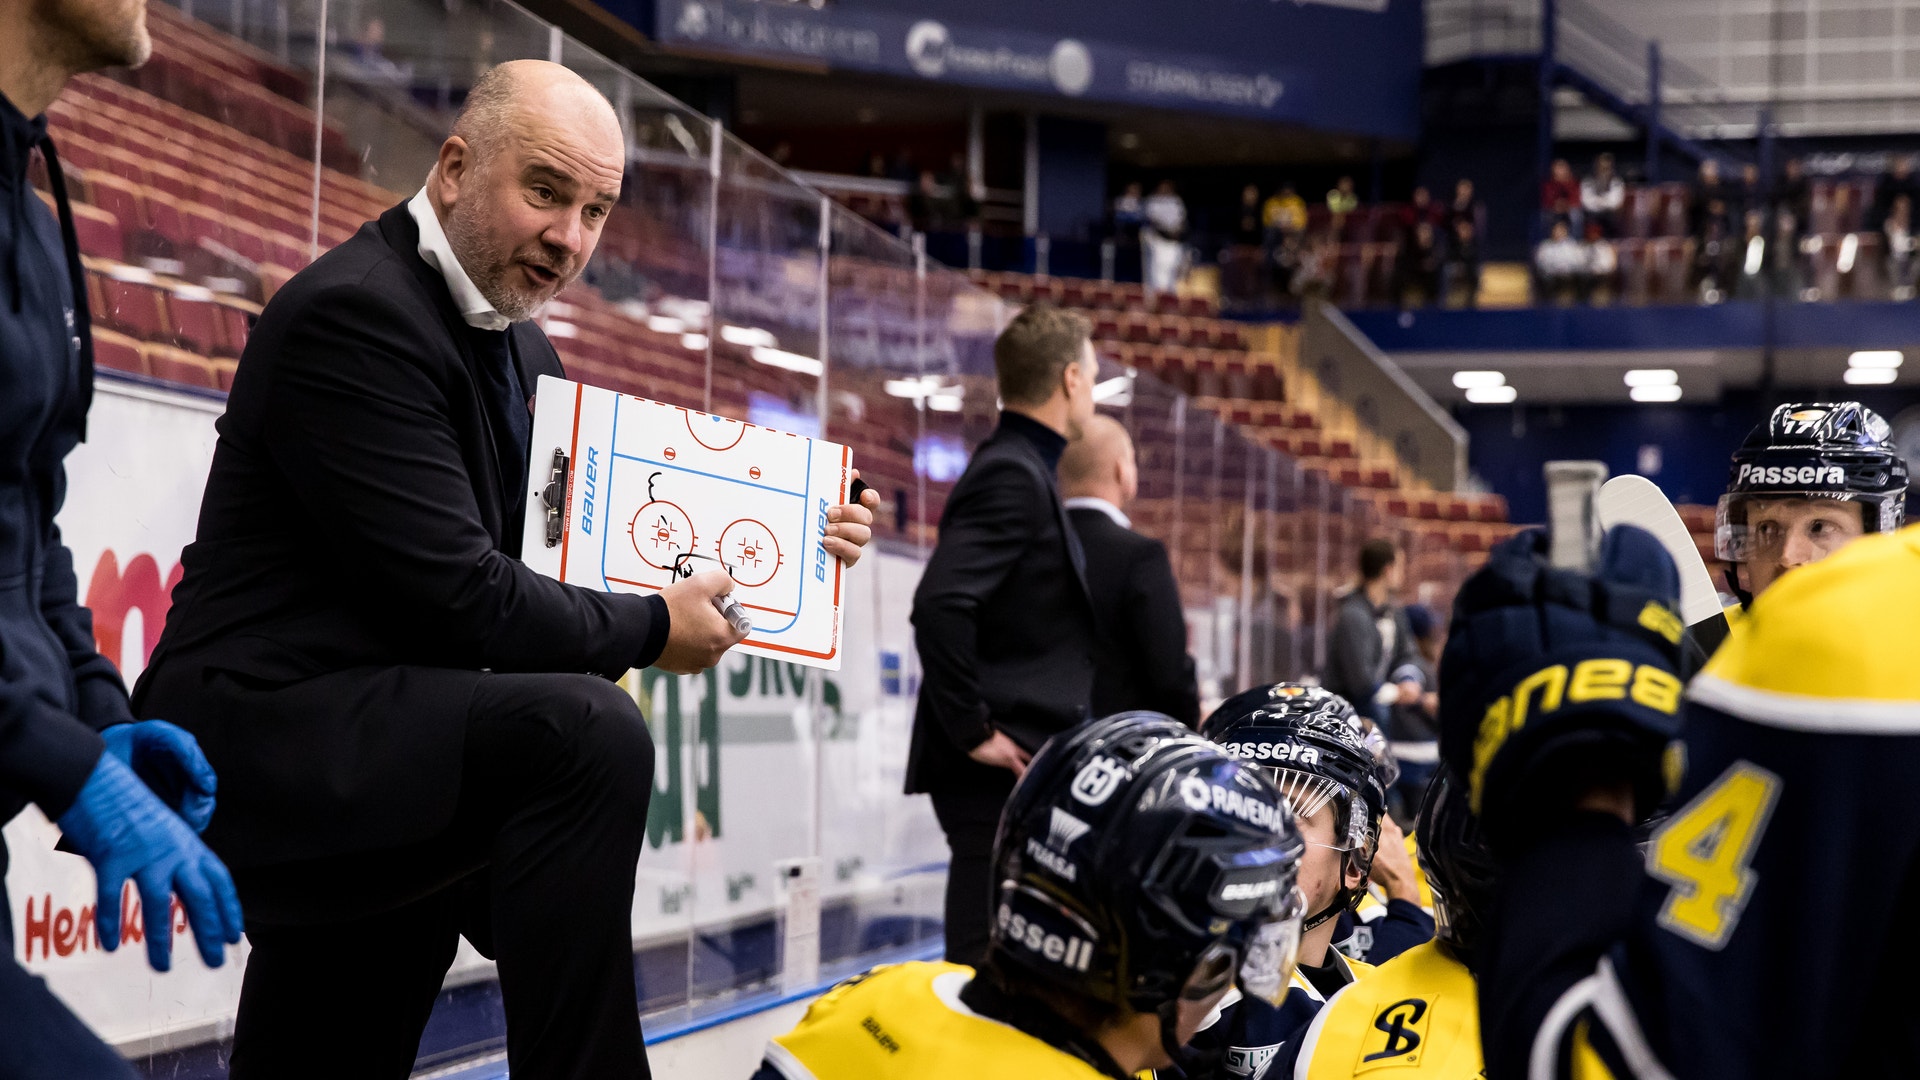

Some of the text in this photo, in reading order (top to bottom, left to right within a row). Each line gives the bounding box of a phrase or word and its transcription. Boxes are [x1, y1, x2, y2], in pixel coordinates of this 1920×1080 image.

[1736, 463, 1845, 486] Passera
[1221, 741, 1319, 765] assera
[1211, 784, 1286, 838] RAVEMA
[1646, 760, 1783, 951] 4
